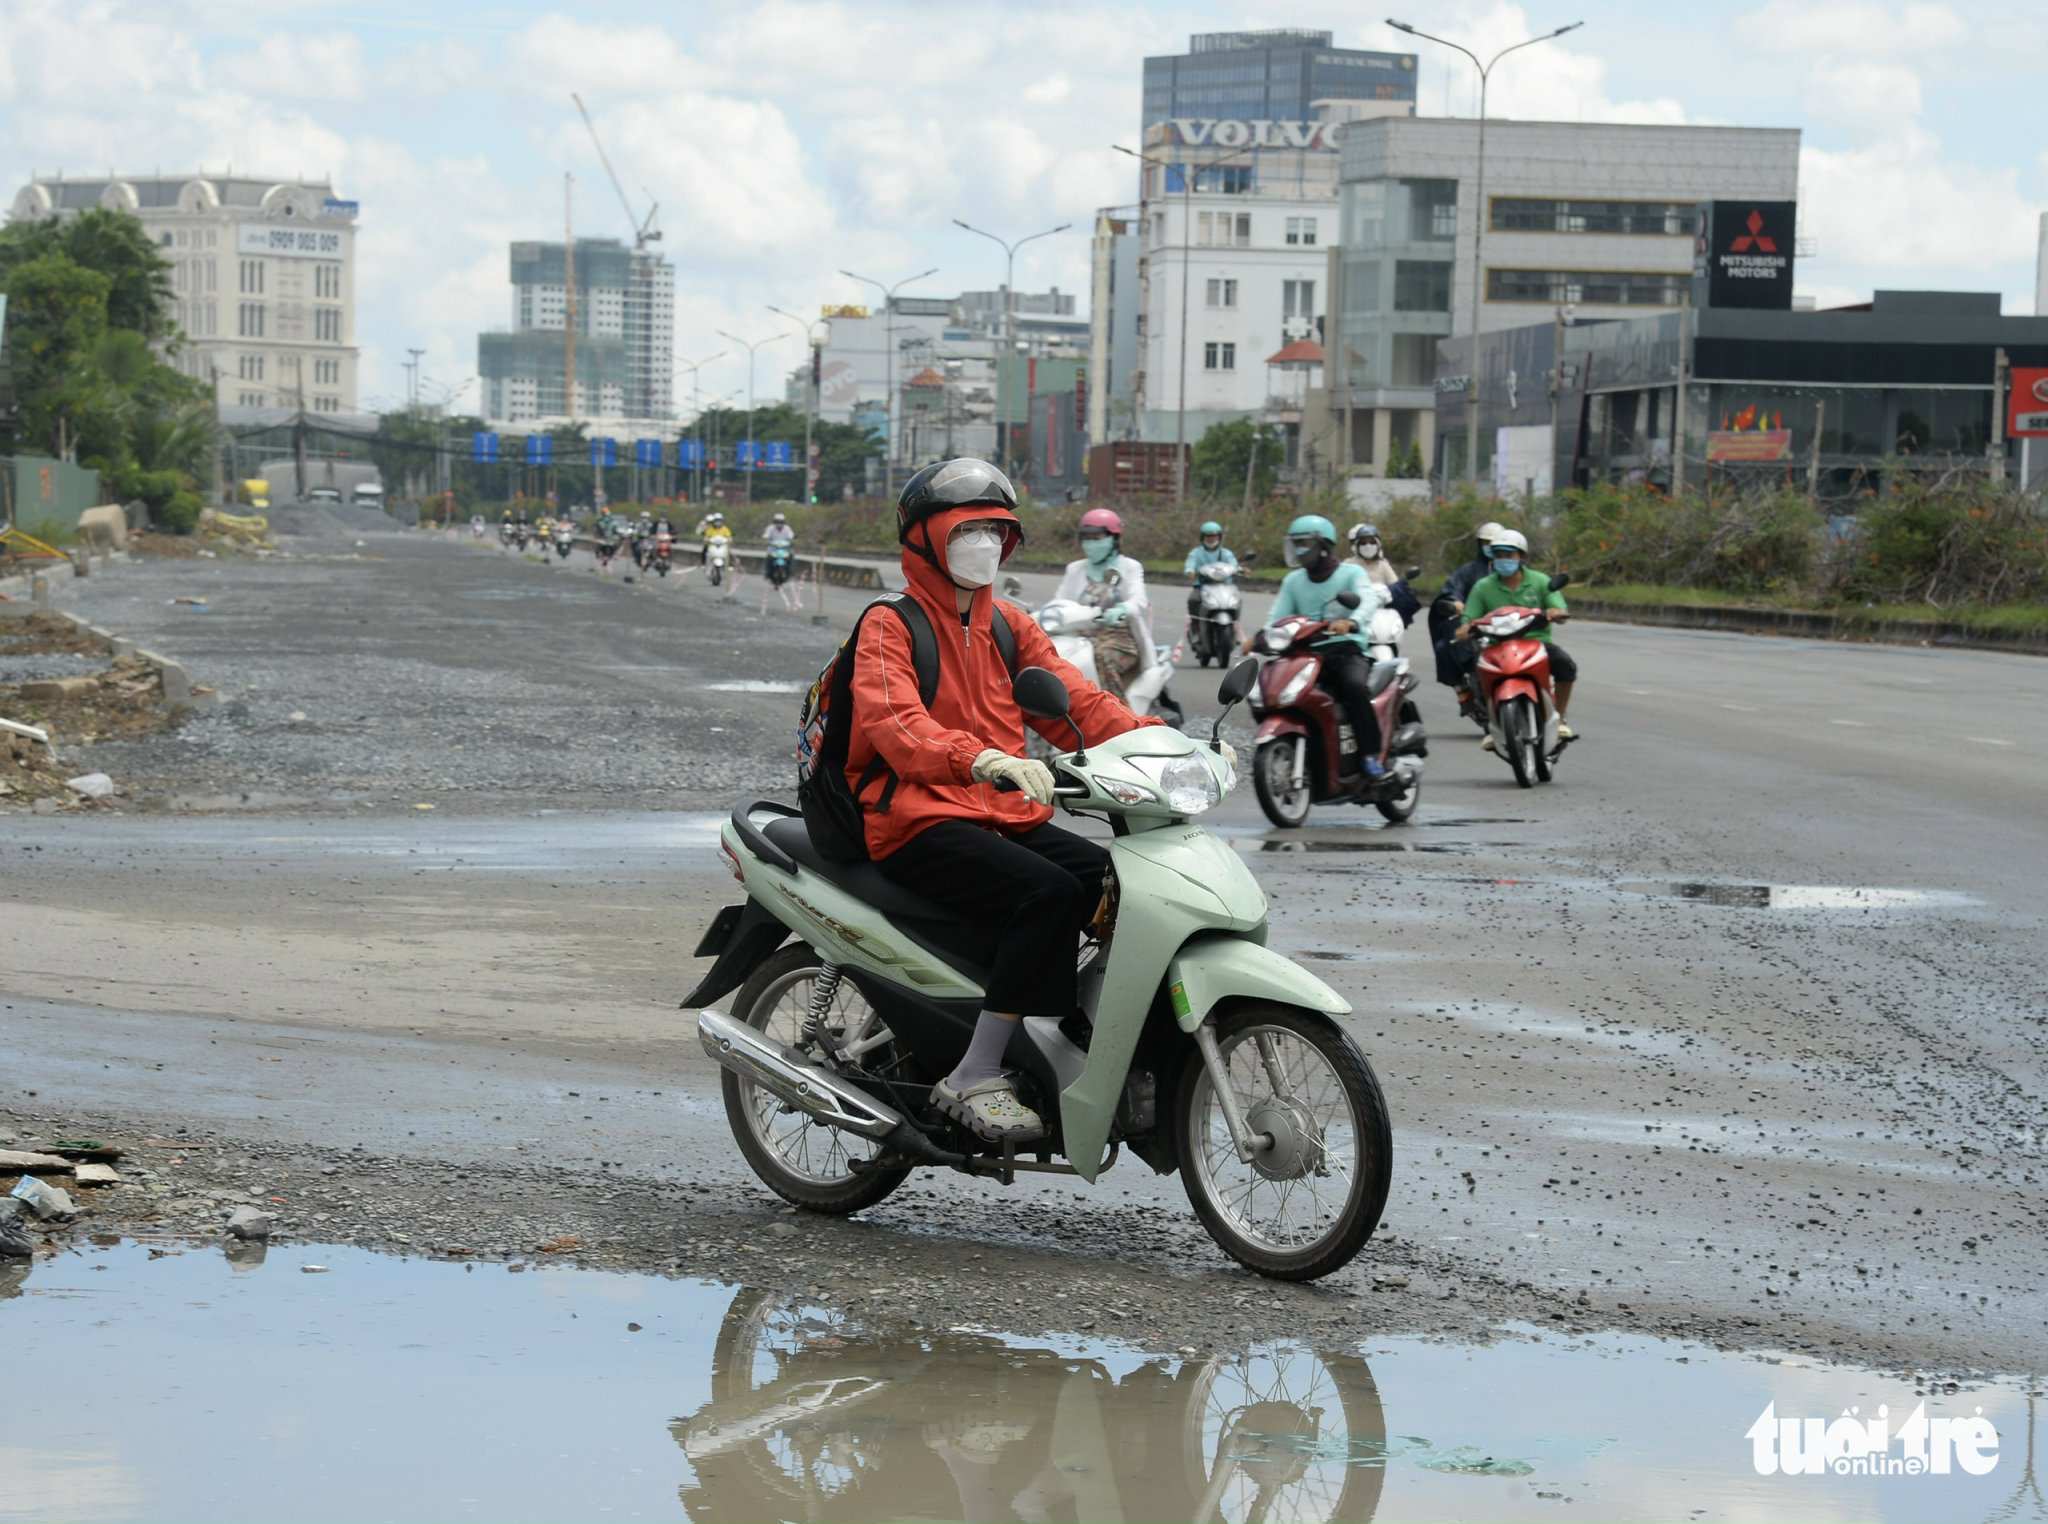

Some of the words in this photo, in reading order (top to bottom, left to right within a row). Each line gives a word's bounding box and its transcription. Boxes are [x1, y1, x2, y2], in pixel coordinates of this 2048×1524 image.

[268, 230, 295, 250] 0909
[298, 231, 317, 252] 005
[320, 233, 338, 253] 009
[1720, 255, 1786, 268] MITSUBISHI
[1727, 267, 1777, 279] MOTORS
